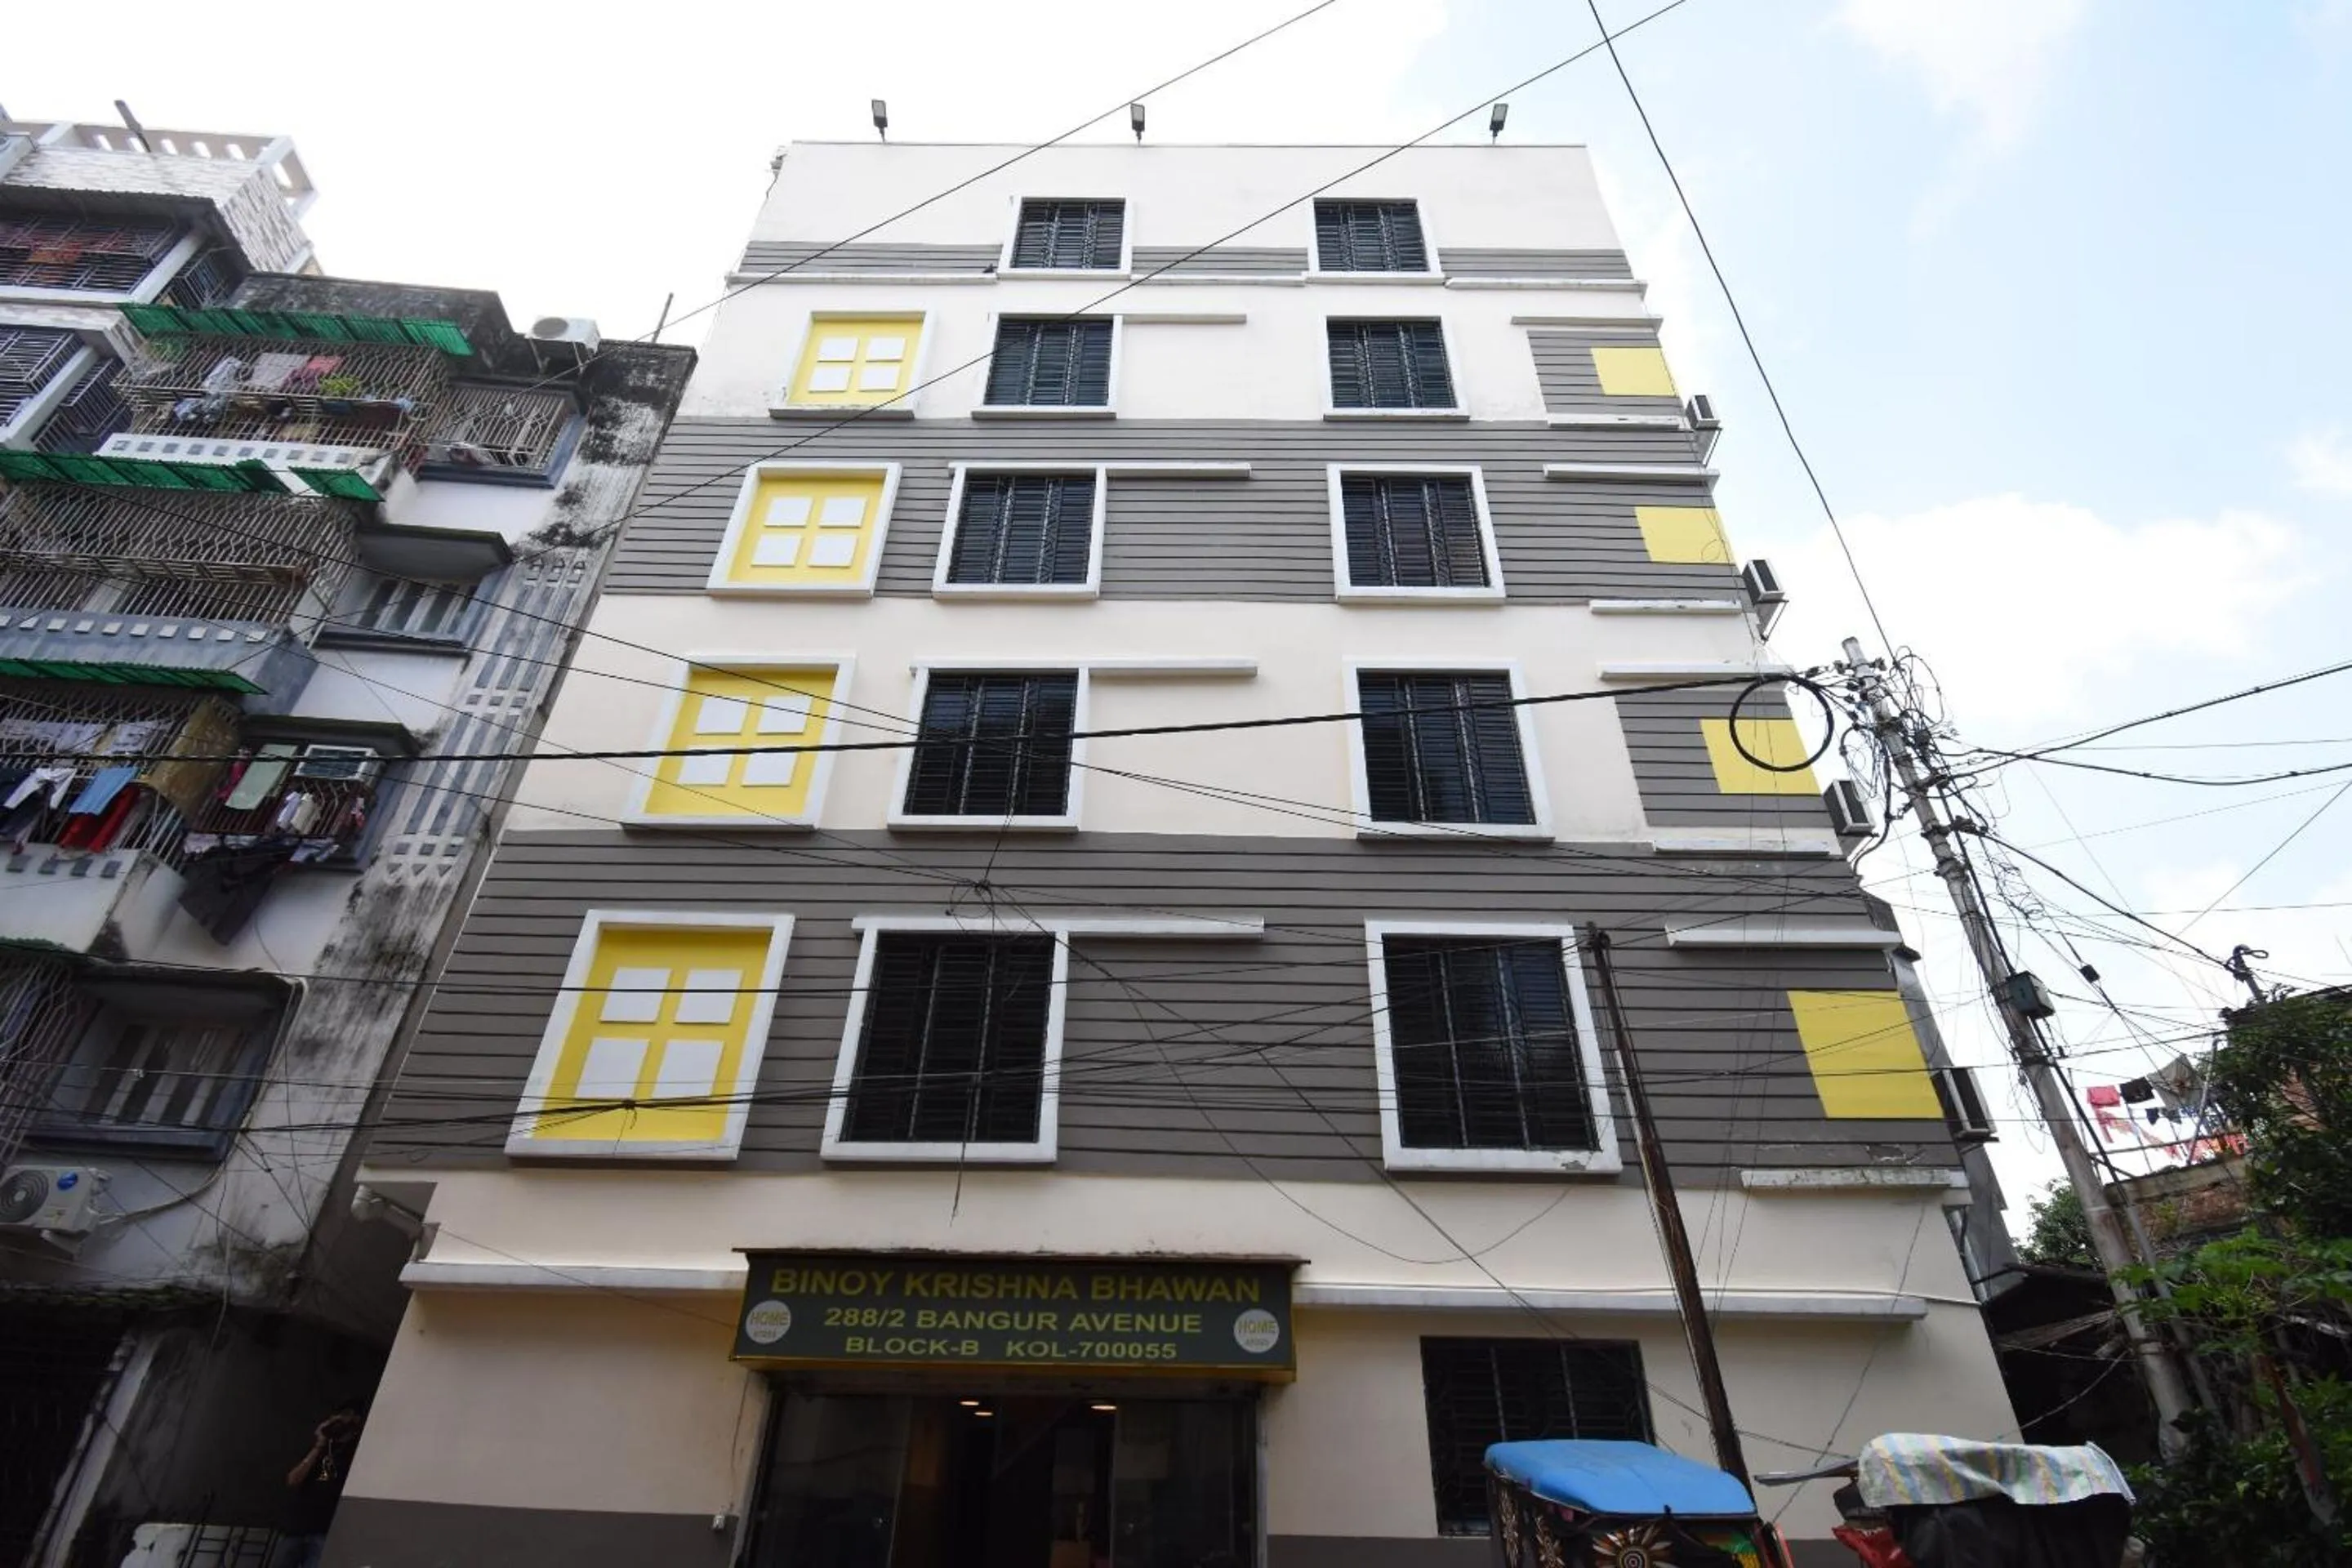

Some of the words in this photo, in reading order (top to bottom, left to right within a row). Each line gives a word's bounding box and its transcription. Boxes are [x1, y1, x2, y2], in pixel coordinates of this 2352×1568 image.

[771, 1270, 895, 1295] BINOY
[904, 1272, 1079, 1299] KRISHNA
[1090, 1276, 1260, 1302] BHAWAN
[824, 1308, 906, 1327] 288/2
[915, 1310, 1057, 1330] BANGUR
[1068, 1313, 1202, 1333] AVENUE
[1238, 1320, 1276, 1334] HOME
[845, 1337, 979, 1356] BLOCK-B
[1005, 1340, 1177, 1359] KOL-700055
